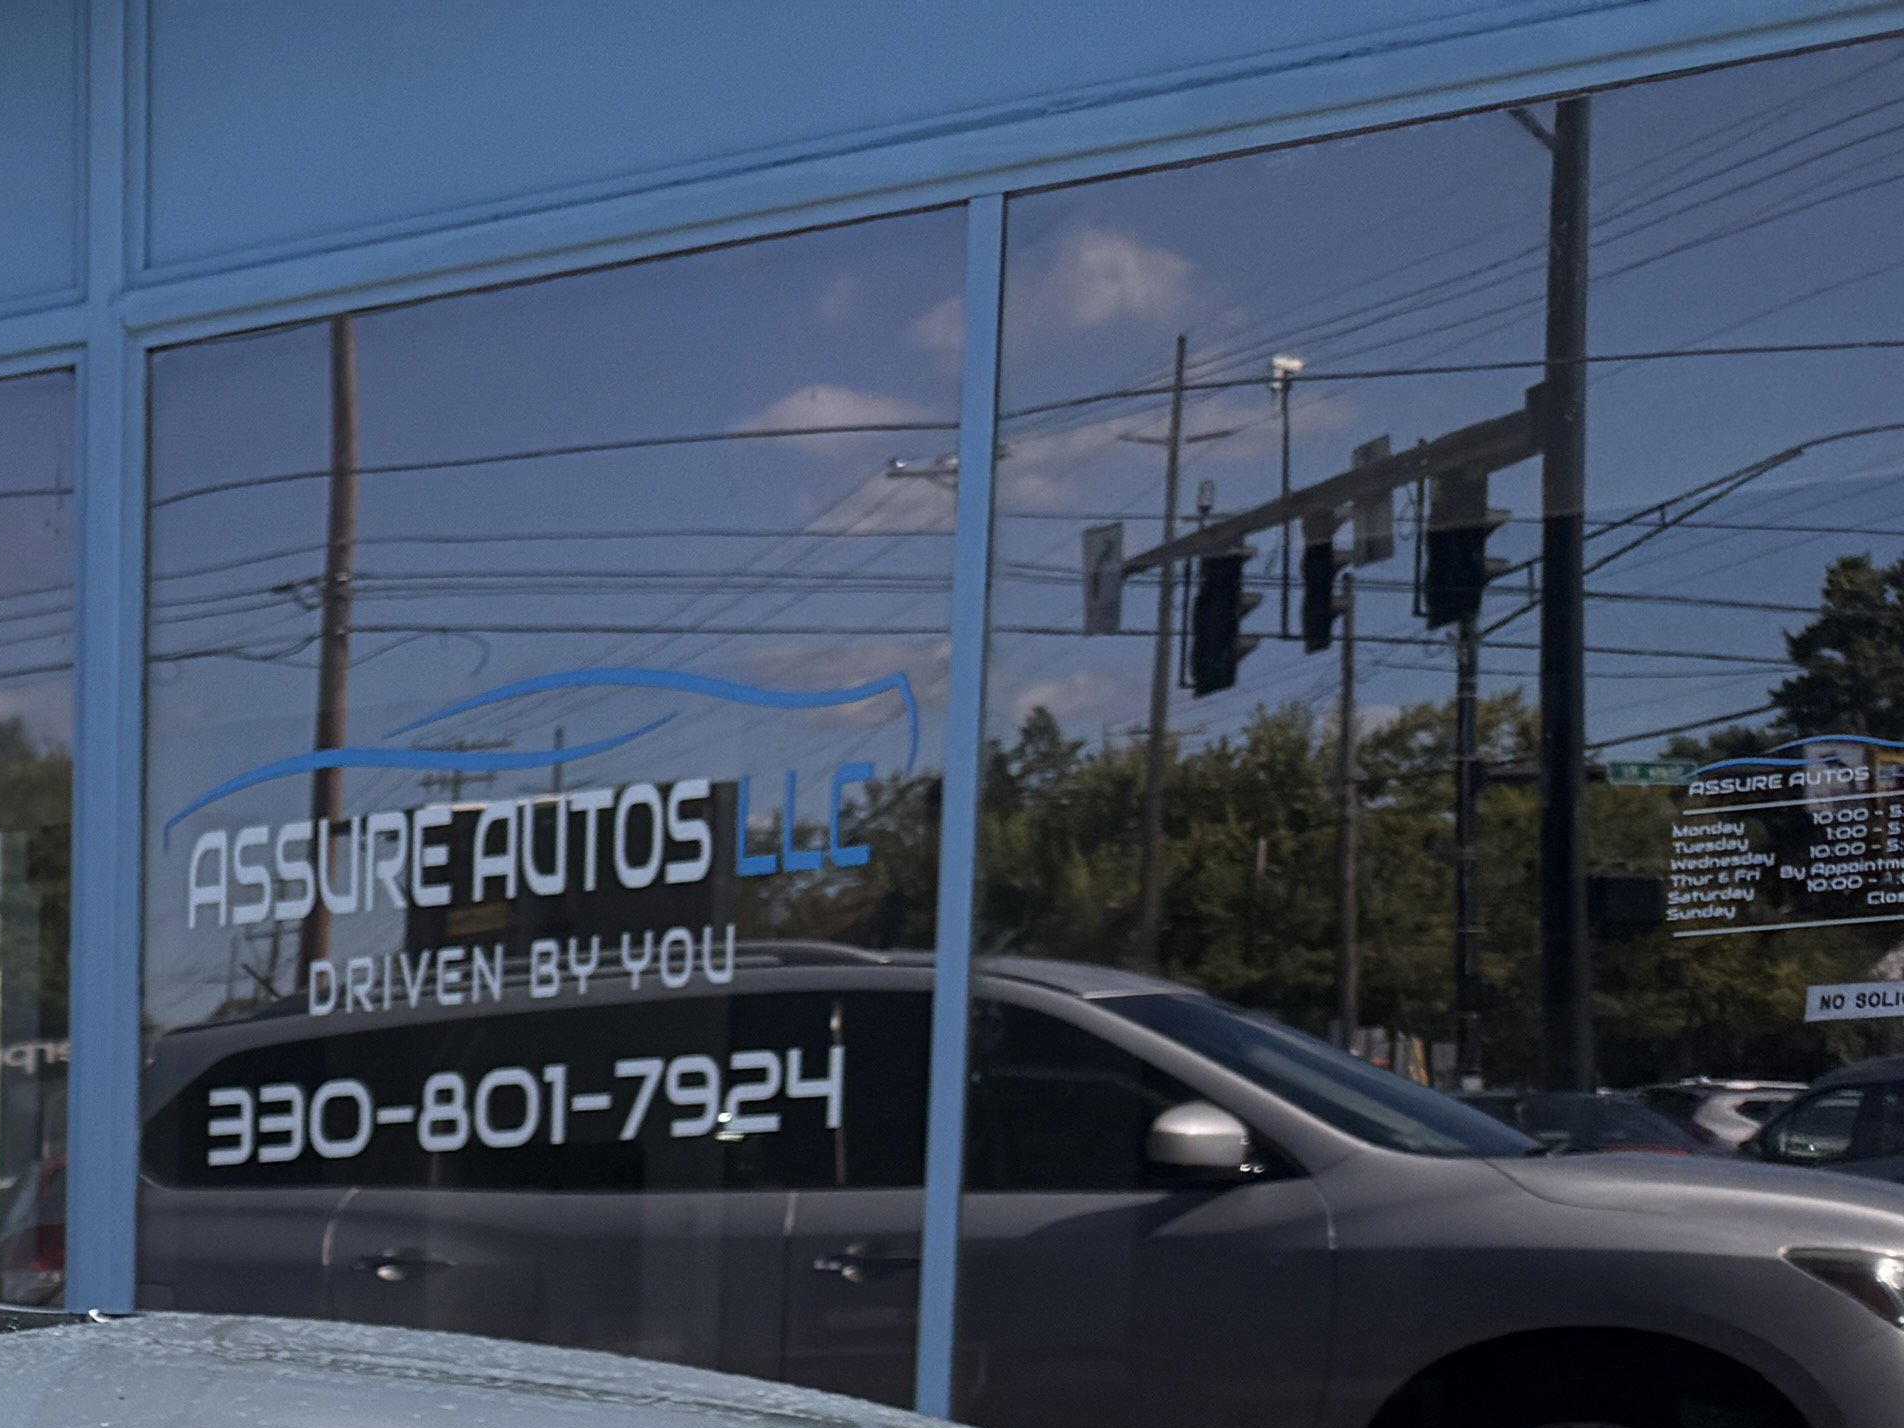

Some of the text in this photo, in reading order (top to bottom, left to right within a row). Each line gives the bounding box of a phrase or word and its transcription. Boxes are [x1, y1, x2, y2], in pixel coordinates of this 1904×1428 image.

[1688, 773, 1783, 796] ASSURE
[1789, 766, 1870, 787] AUTOS
[1672, 821, 1745, 838] Monday
[187, 761, 875, 929] ASSURE AUTOS LLC
[1673, 837, 1749, 853] Tuesday
[1671, 852, 1776, 871] Wednesday
[1668, 887, 1755, 905] Saturday
[1666, 904, 1736, 921] Sunday
[308, 923, 736, 1017] DRIVEN BY YOU
[1820, 991, 1904, 1010] NO SOLI
[206, 1045, 845, 1167] 330-801-7924
